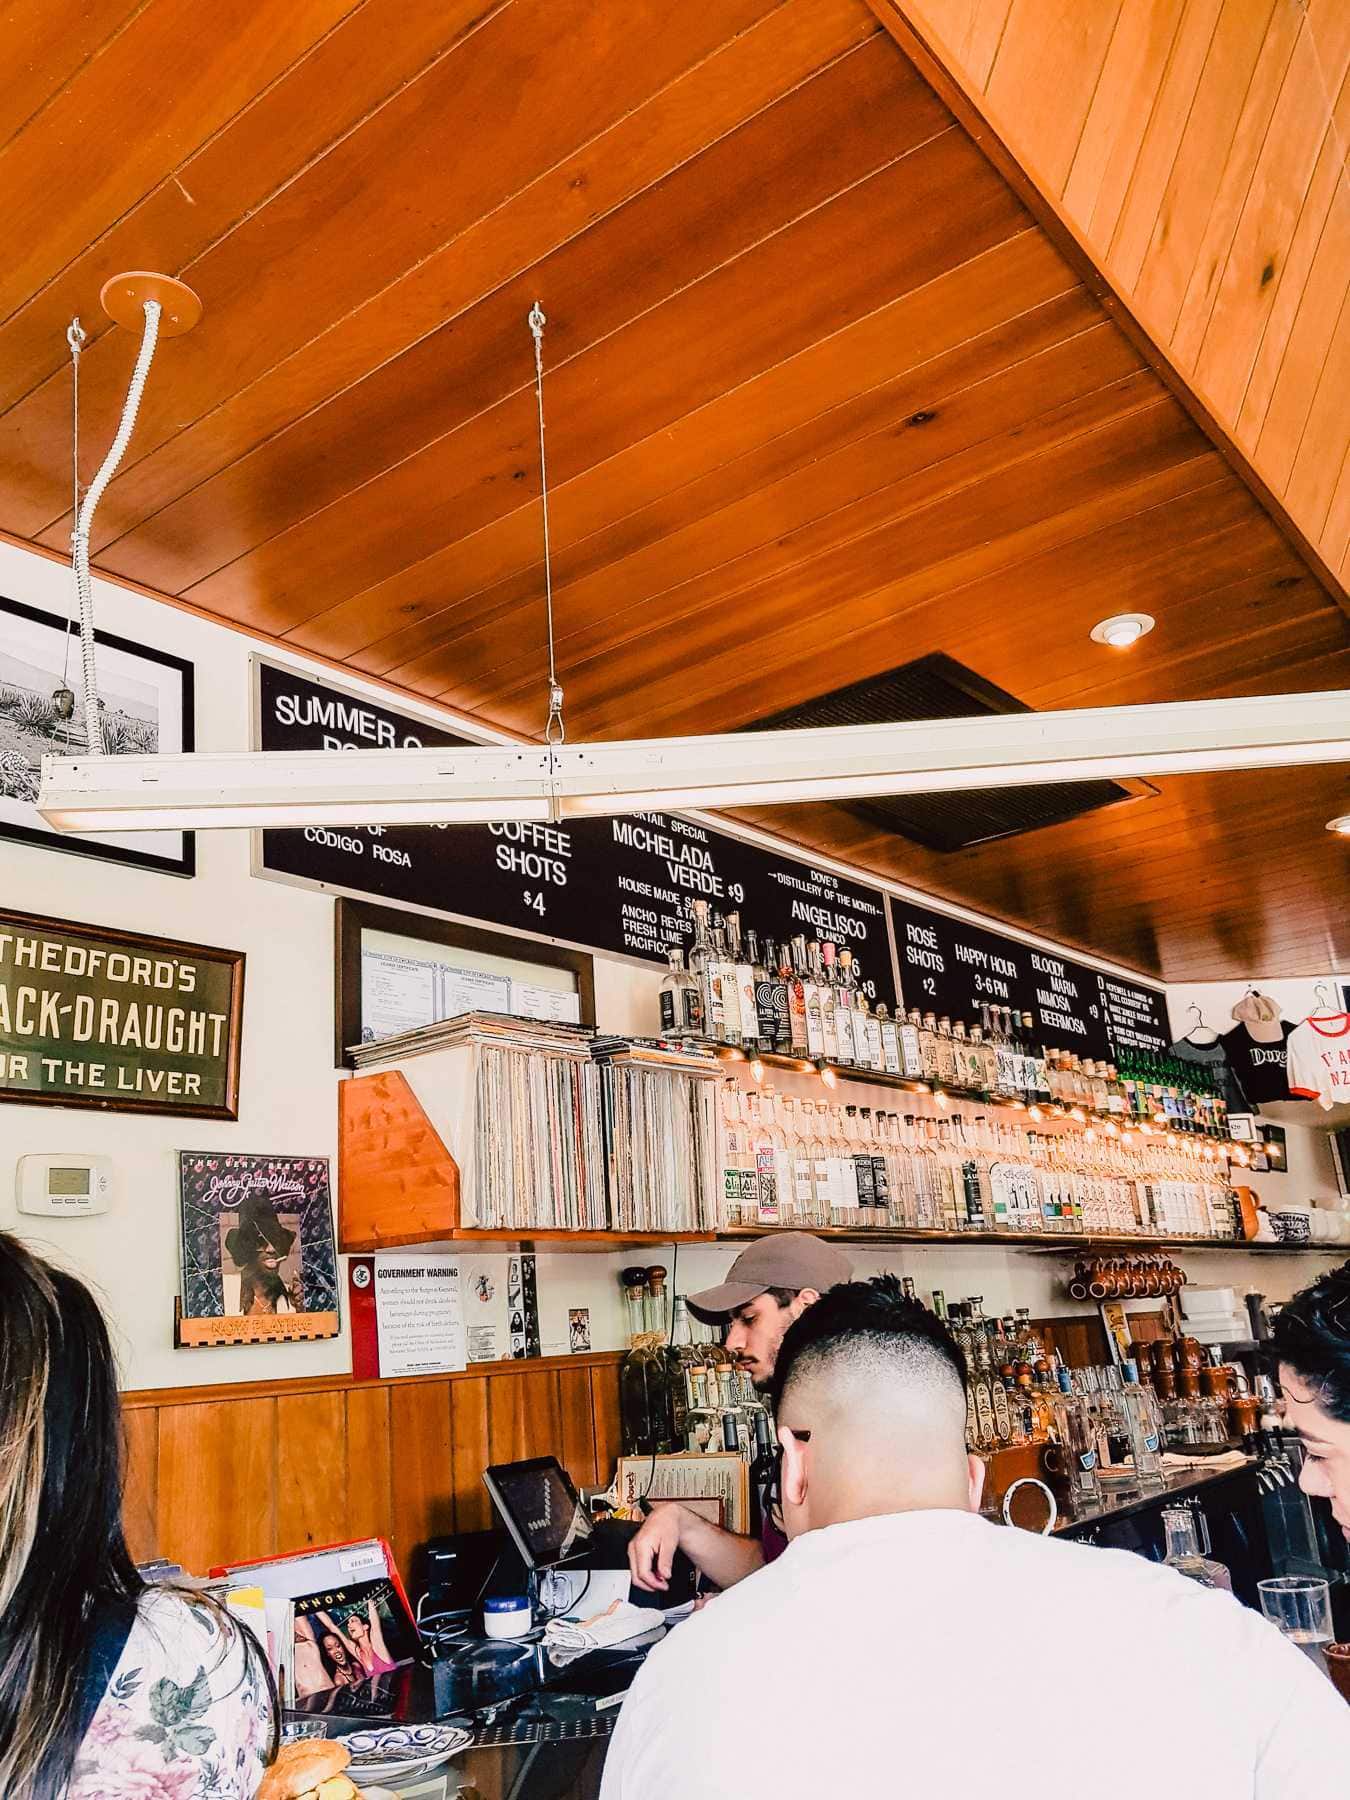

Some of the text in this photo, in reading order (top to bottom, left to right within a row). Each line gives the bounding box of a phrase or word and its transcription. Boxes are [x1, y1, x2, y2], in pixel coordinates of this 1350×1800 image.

[275, 695, 396, 749] SUMMER
[671, 820, 709, 843] SPECIAL
[373, 844, 412, 868] ROSA
[612, 819, 715, 873] MICHELADA
[496, 844, 567, 886] SHOTS
[618, 876, 652, 897] HOUSE
[653, 886, 680, 905] MADE
[667, 861, 724, 898] VERDE
[728, 883, 744, 904] $9
[811, 870, 838, 889] DOVE'S
[523, 891, 546, 916] $4
[777, 872, 876, 915] DISTILLERY OF THE MONTH
[621, 904, 693, 933] ANCHO REYES
[791, 900, 867, 940] ANGELISCO
[622, 918, 684, 945] FRESH LIME
[816, 927, 845, 945] BLANCO
[0, 934, 197, 993] THEDFORD'S
[907, 946, 945, 973] SHOTS
[955, 943, 1018, 979] HAPPY HOUR
[1031, 953, 1065, 978] BLOODY
[862, 980, 876, 998] $8
[923, 977, 936, 997] $2
[1050, 976, 1078, 998] MARIA
[1036, 988, 1072, 1013] MIMOSA
[1040, 1009, 1087, 1035] BEERMOSA
[41, 1058, 106, 1088] THE
[117, 1066, 201, 1096] LIVER
[190, 1159, 322, 1171] THE VERY BEST OF
[377, 1268, 458, 1279] GOVERNMENT WARNING
[211, 1318, 312, 1337] NOW PLAYING
[297, 1592, 347, 1611] NNON
